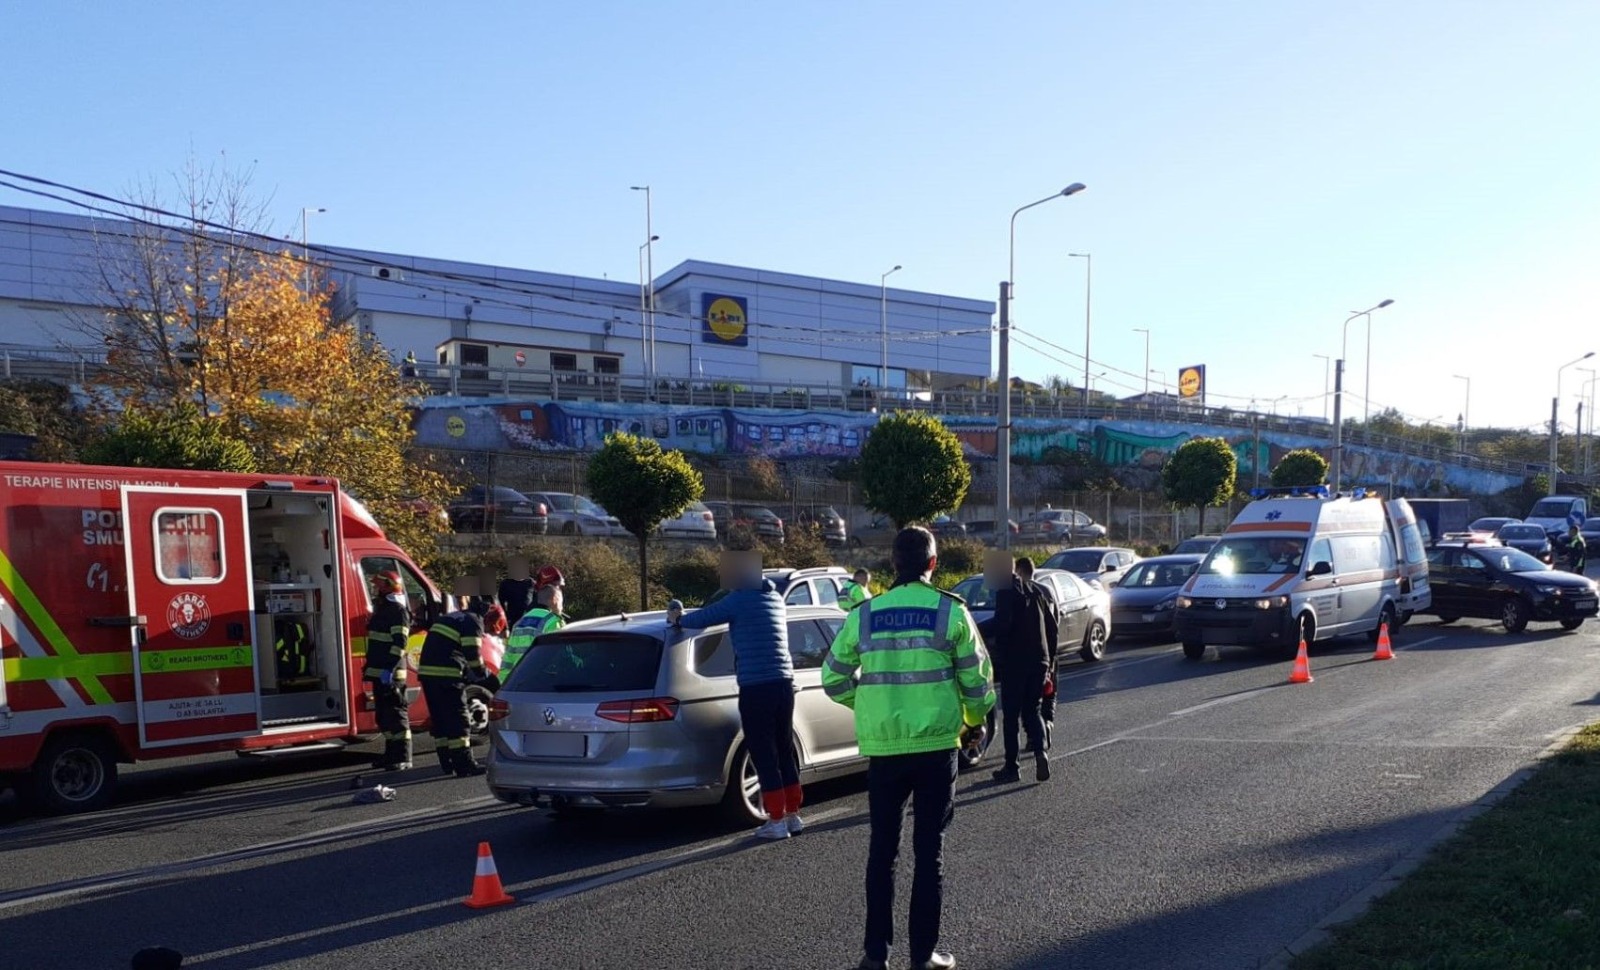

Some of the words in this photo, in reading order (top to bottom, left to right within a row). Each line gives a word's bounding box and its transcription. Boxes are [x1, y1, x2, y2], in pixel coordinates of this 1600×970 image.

[5, 475, 63, 488] TERAPIE
[67, 478, 130, 490] INTENSIVA
[83, 530, 125, 545] SMU
[171, 594, 204, 609] BEARD
